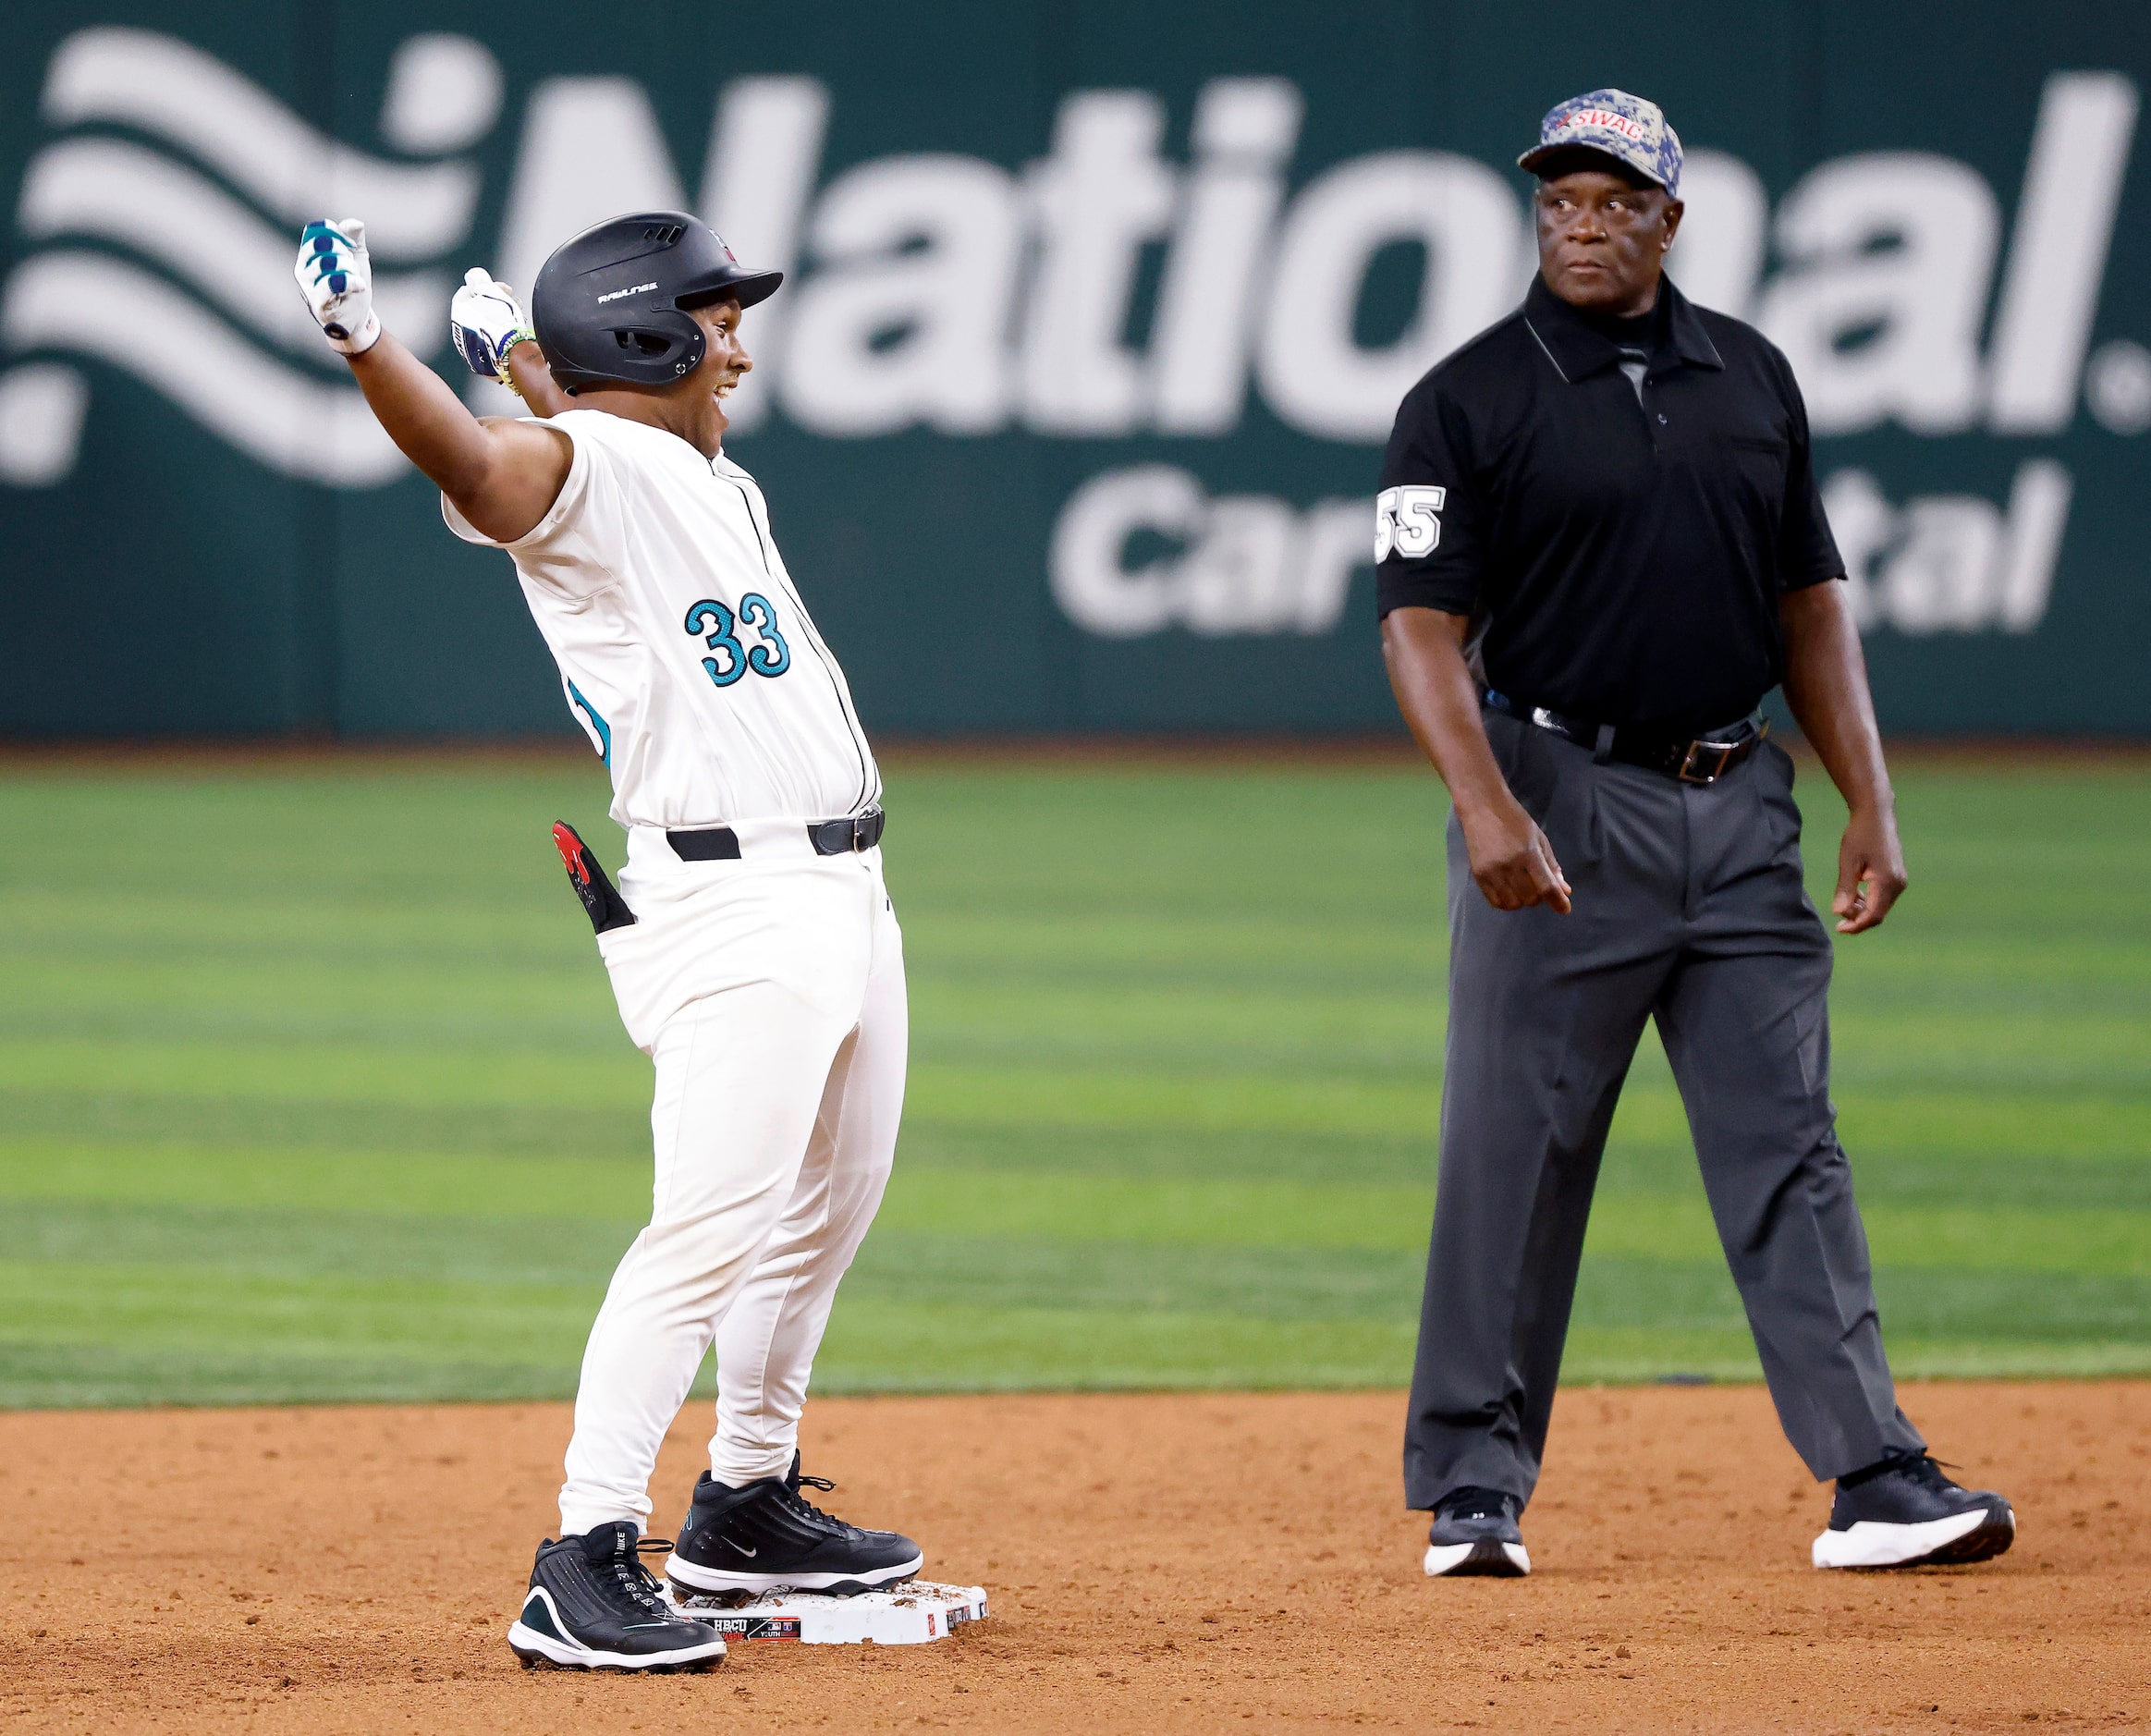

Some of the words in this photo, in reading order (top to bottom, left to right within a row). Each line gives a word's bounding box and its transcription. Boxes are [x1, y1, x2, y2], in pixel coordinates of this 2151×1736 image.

[1573, 110, 1643, 140] SWAC
[597, 281, 658, 304] RAWLINGS
[1375, 485, 1447, 565] 55
[684, 592, 791, 688] 33
[616, 1531, 626, 1551] NIKE
[714, 1619, 748, 1632] HBCU
